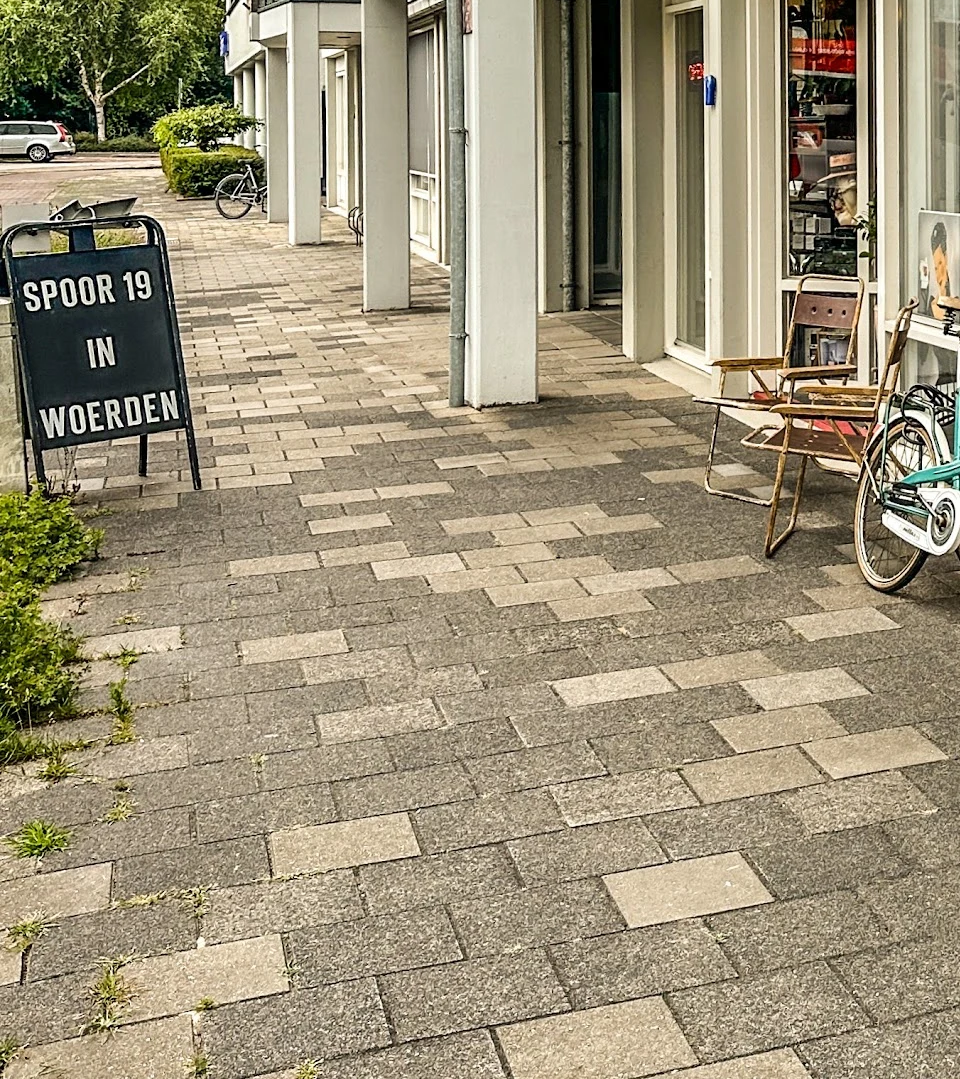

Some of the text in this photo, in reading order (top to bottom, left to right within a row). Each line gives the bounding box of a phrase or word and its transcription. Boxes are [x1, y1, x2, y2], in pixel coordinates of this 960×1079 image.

[23, 270, 152, 312] SPOOR 19
[86, 336, 116, 369] IN
[39, 390, 180, 439] WOERDEN
